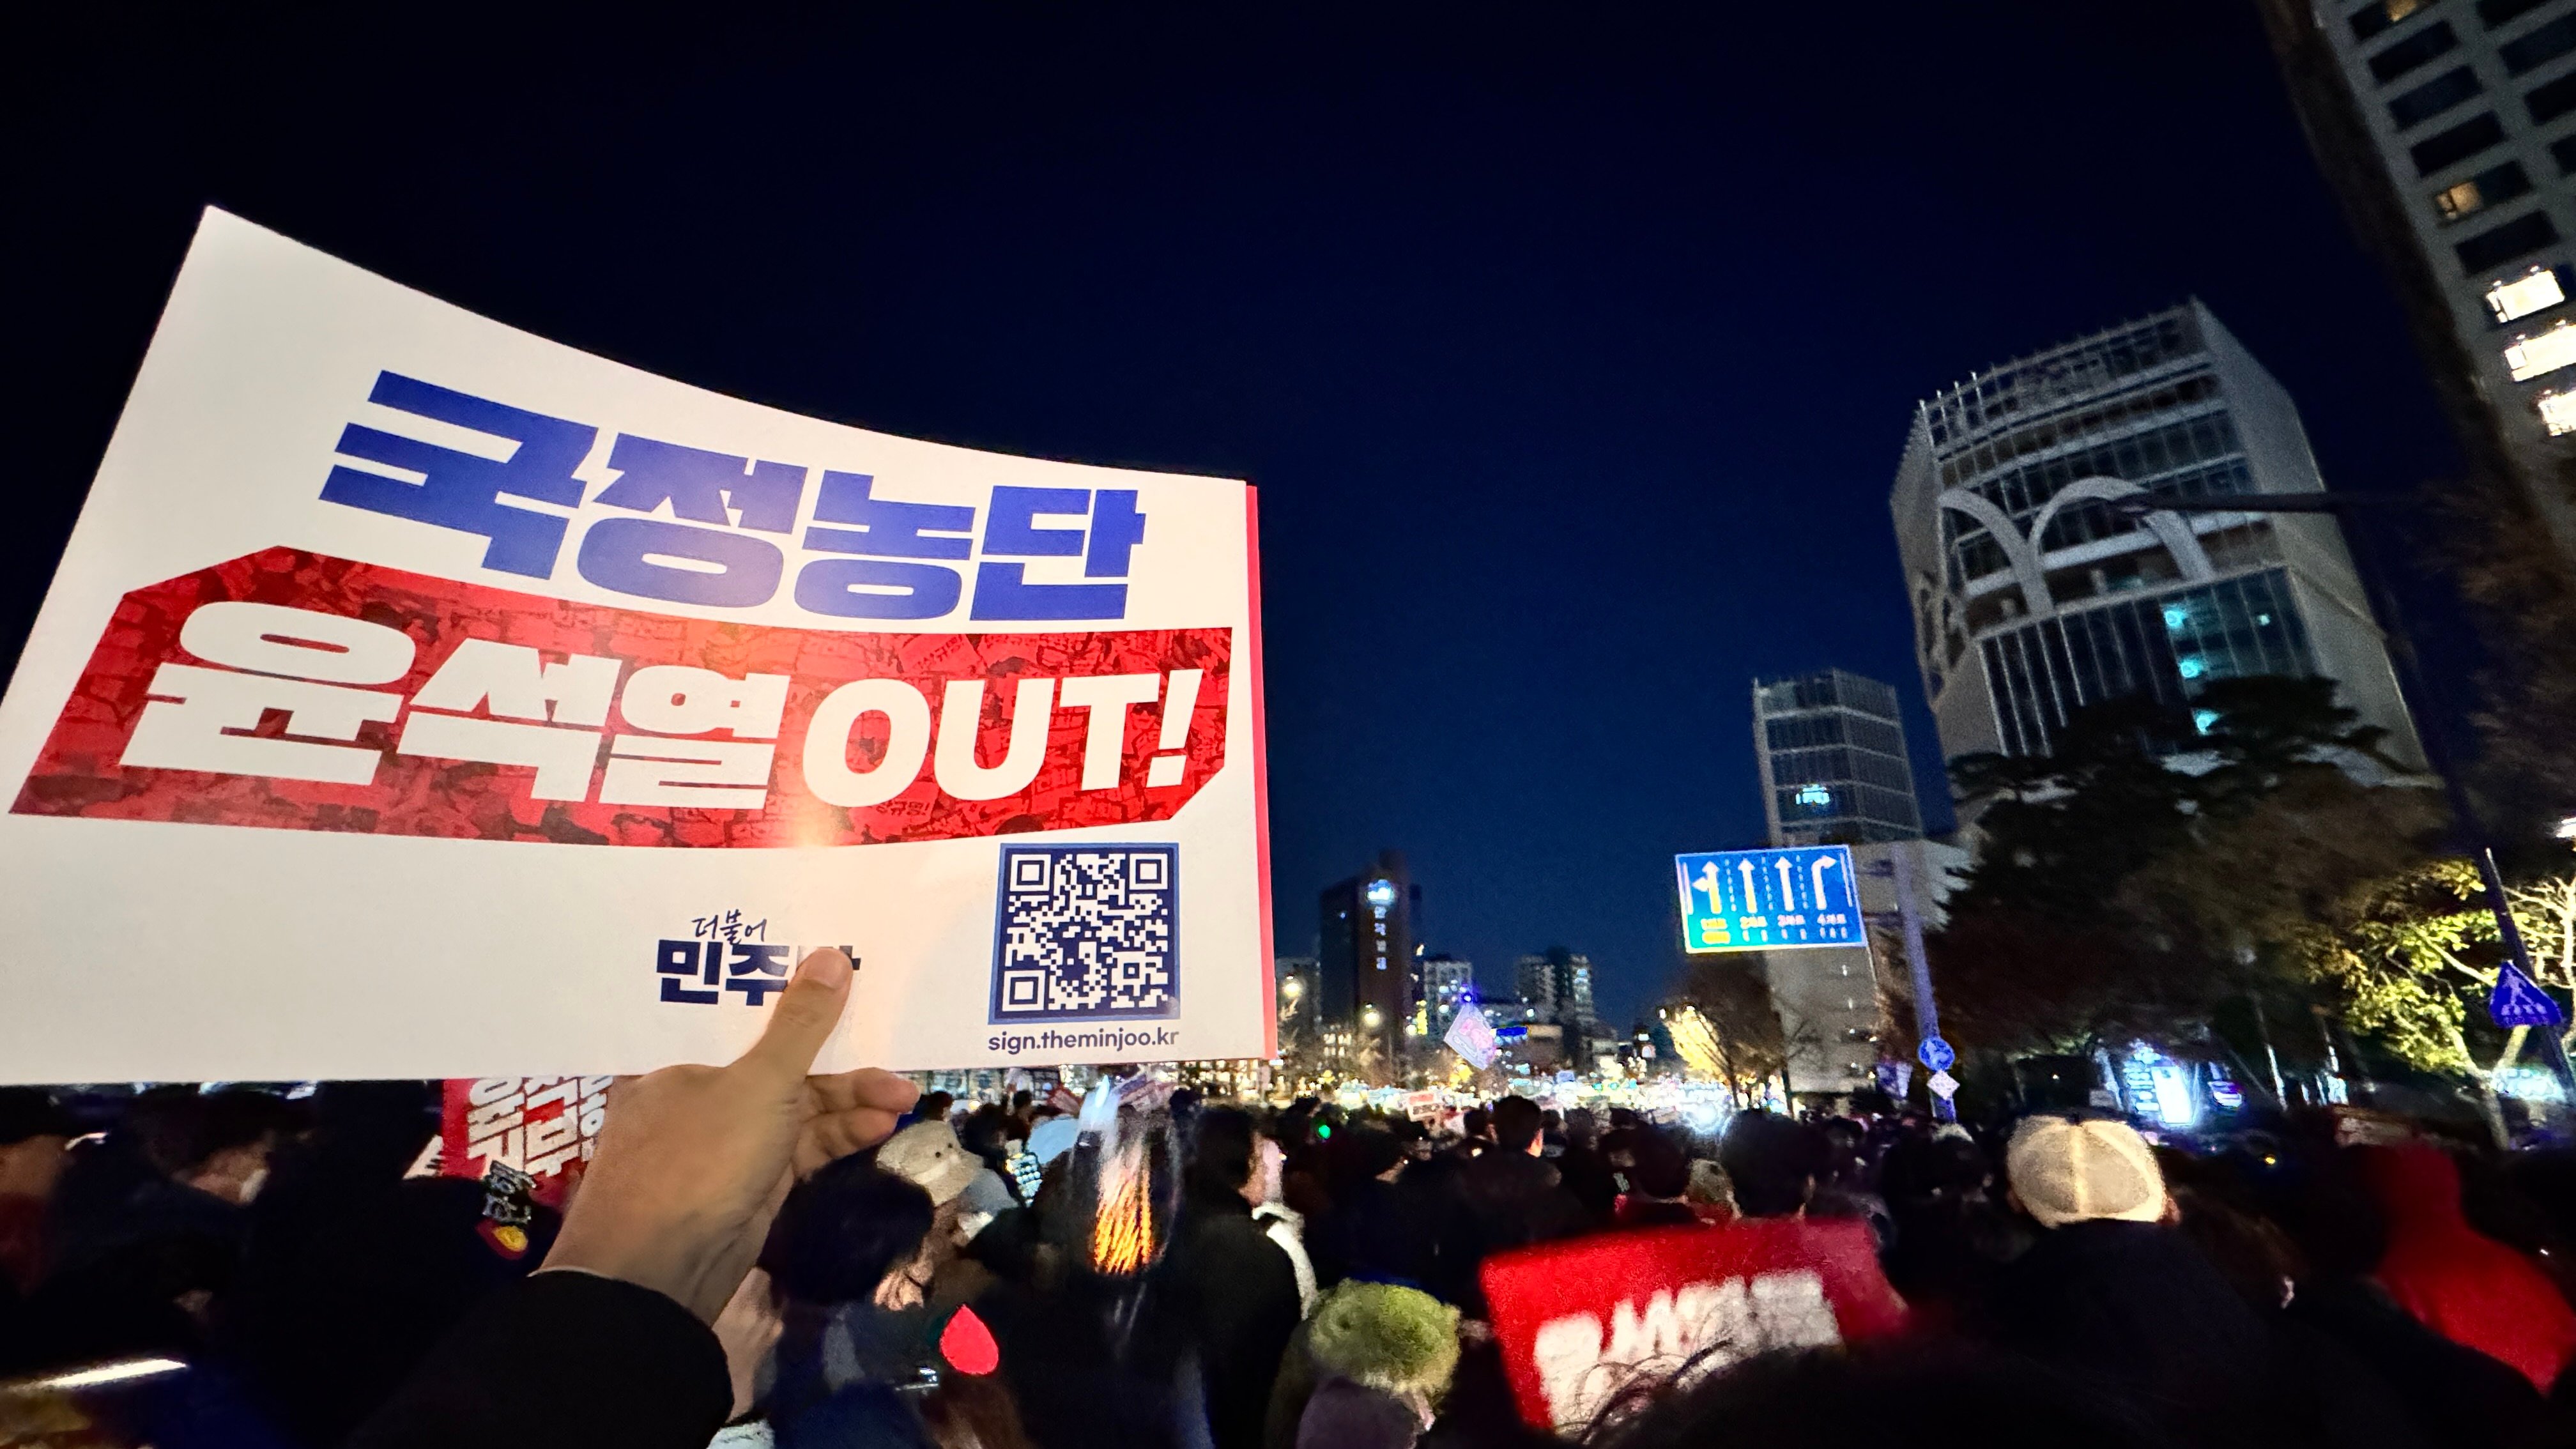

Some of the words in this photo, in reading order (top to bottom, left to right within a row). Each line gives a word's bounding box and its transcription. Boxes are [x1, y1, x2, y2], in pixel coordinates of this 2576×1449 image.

[318, 369, 1146, 622] 국정농단
[119, 601, 791, 810] 윤석열
[801, 668, 1203, 808] OUT!
[691, 908, 767, 945] 더불어
[656, 939, 861, 1006] 민주
[988, 1027, 1179, 1055] sign.theminjoo.kr
